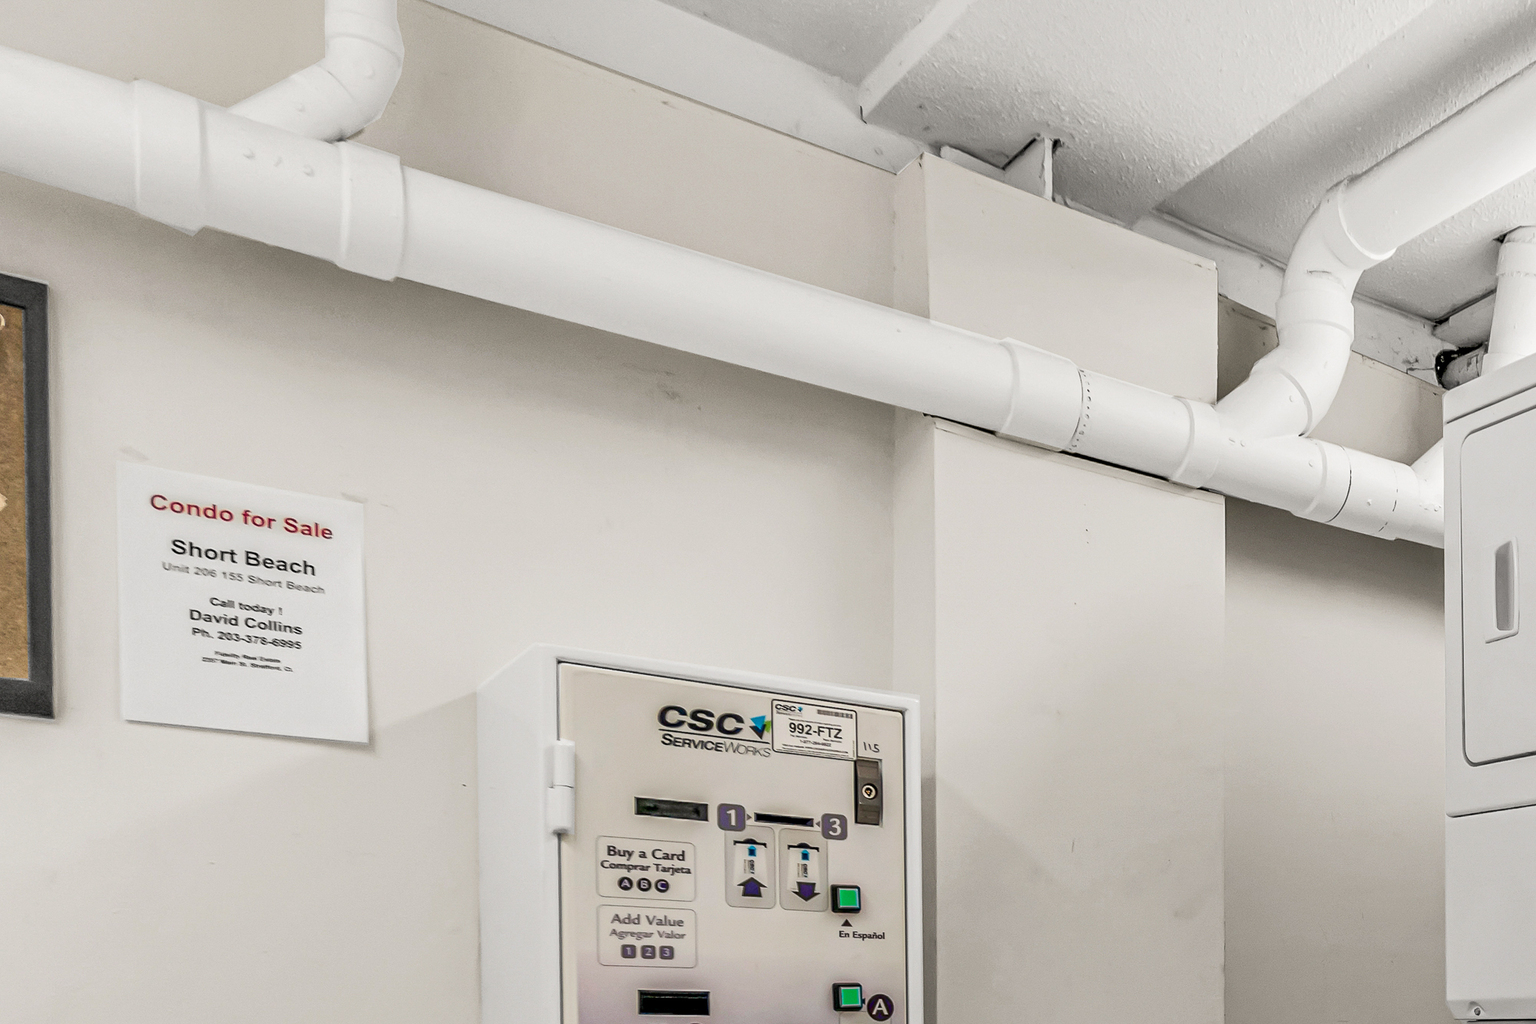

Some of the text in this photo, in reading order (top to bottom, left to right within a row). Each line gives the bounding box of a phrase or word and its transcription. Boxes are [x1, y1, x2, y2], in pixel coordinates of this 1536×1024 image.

[150, 494, 333, 540] Condo for Sale
[171, 539, 316, 576] Short Beach
[162, 561, 326, 594] Unit 206 155 Short Beach
[209, 597, 235, 609] Call
[238, 602, 275, 616] today
[189, 609, 303, 635] David Collins
[192, 627, 214, 639] Ph.
[657, 704, 745, 735] CSC
[789, 722, 843, 740] 992-FTZ
[607, 845, 686, 861] Buy a Card
[600, 860, 692, 876] Comprar Tarjeta
[611, 913, 685, 927] Add Value
[609, 928, 687, 940] Agregar Valor
[839, 930, 886, 942] En Español
[872, 999, 889, 1016] A
